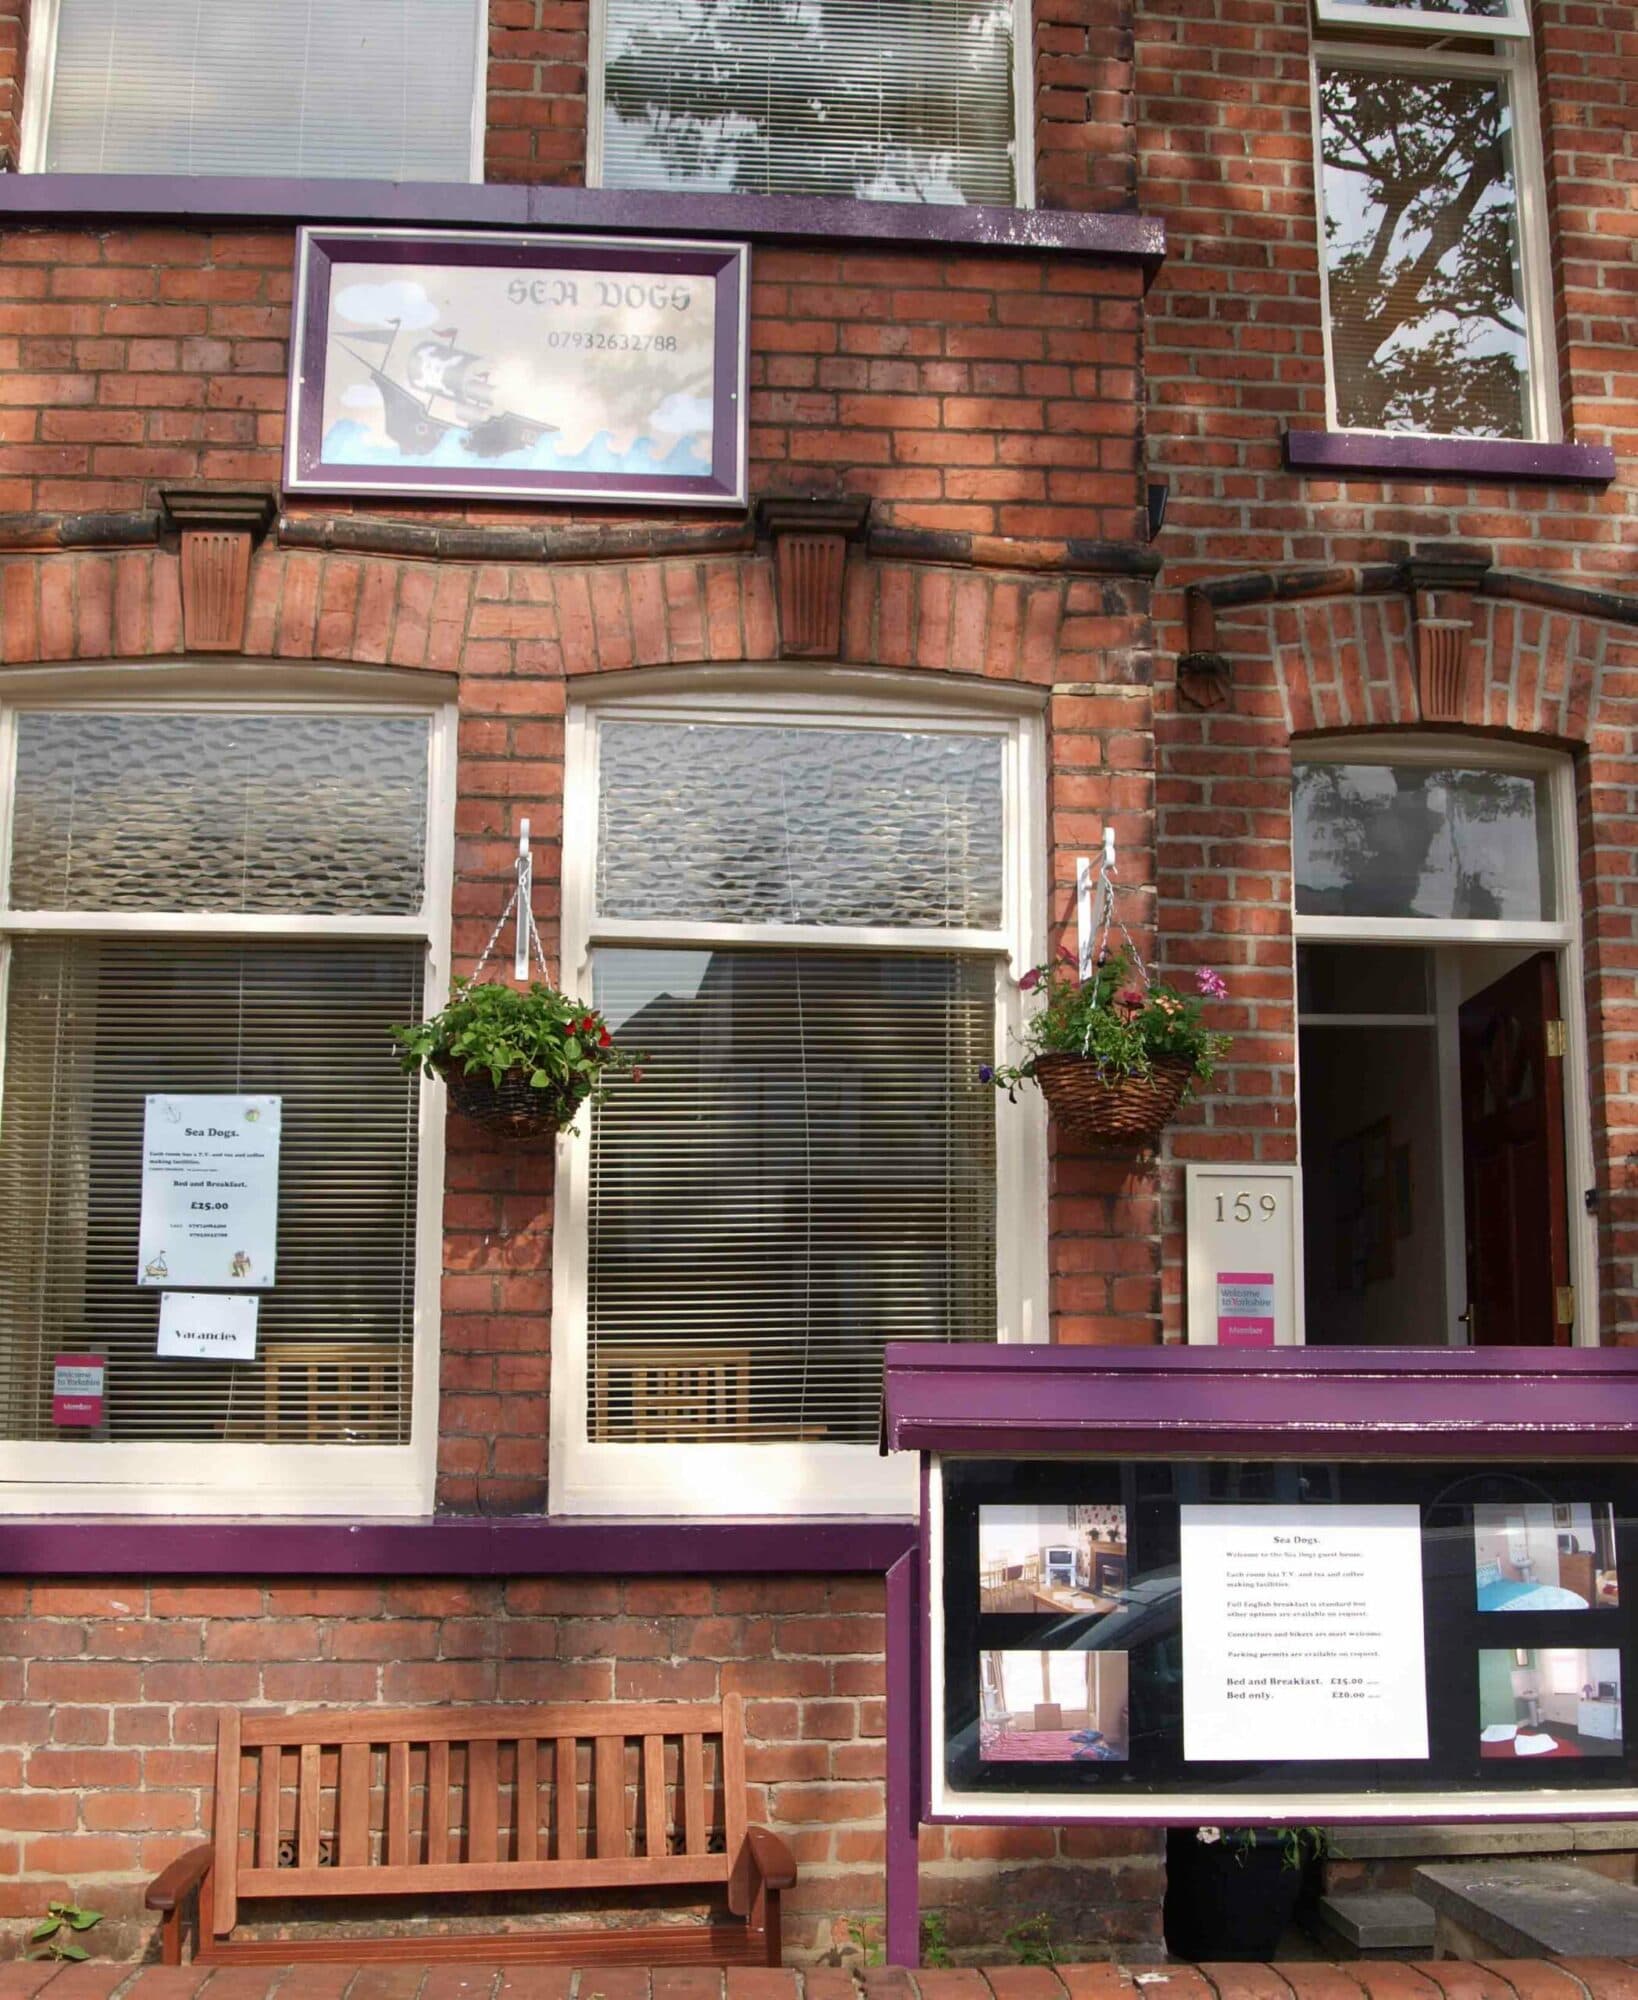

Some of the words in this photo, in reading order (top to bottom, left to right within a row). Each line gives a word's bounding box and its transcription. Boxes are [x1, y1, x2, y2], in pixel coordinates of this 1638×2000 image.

[507, 279, 578, 307] SEA
[595, 281, 691, 312] DOGS
[548, 331, 677, 352] 07932632788
[184, 1127, 205, 1137] Sea
[173, 1180, 188, 1188] Bed
[189, 1180, 205, 1188] and
[206, 1180, 248, 1189] Breakfast.
[190, 1201, 230, 1211] £25.00
[1215, 1192, 1277, 1223] 159
[1221, 1287, 1261, 1297] Welcome
[1222, 1297, 1231, 1306] to
[1232, 1297, 1272, 1306] Yorkshire
[175, 1329, 238, 1342] Vacancies
[1273, 1535, 1291, 1544] Sea
[1226, 1677, 1246, 1686] Bed
[1247, 1677, 1268, 1686] and
[1269, 1677, 1324, 1686] Breakfast.
[1226, 1691, 1246, 1700] Bed
[1248, 1691, 1275, 1701] only.
